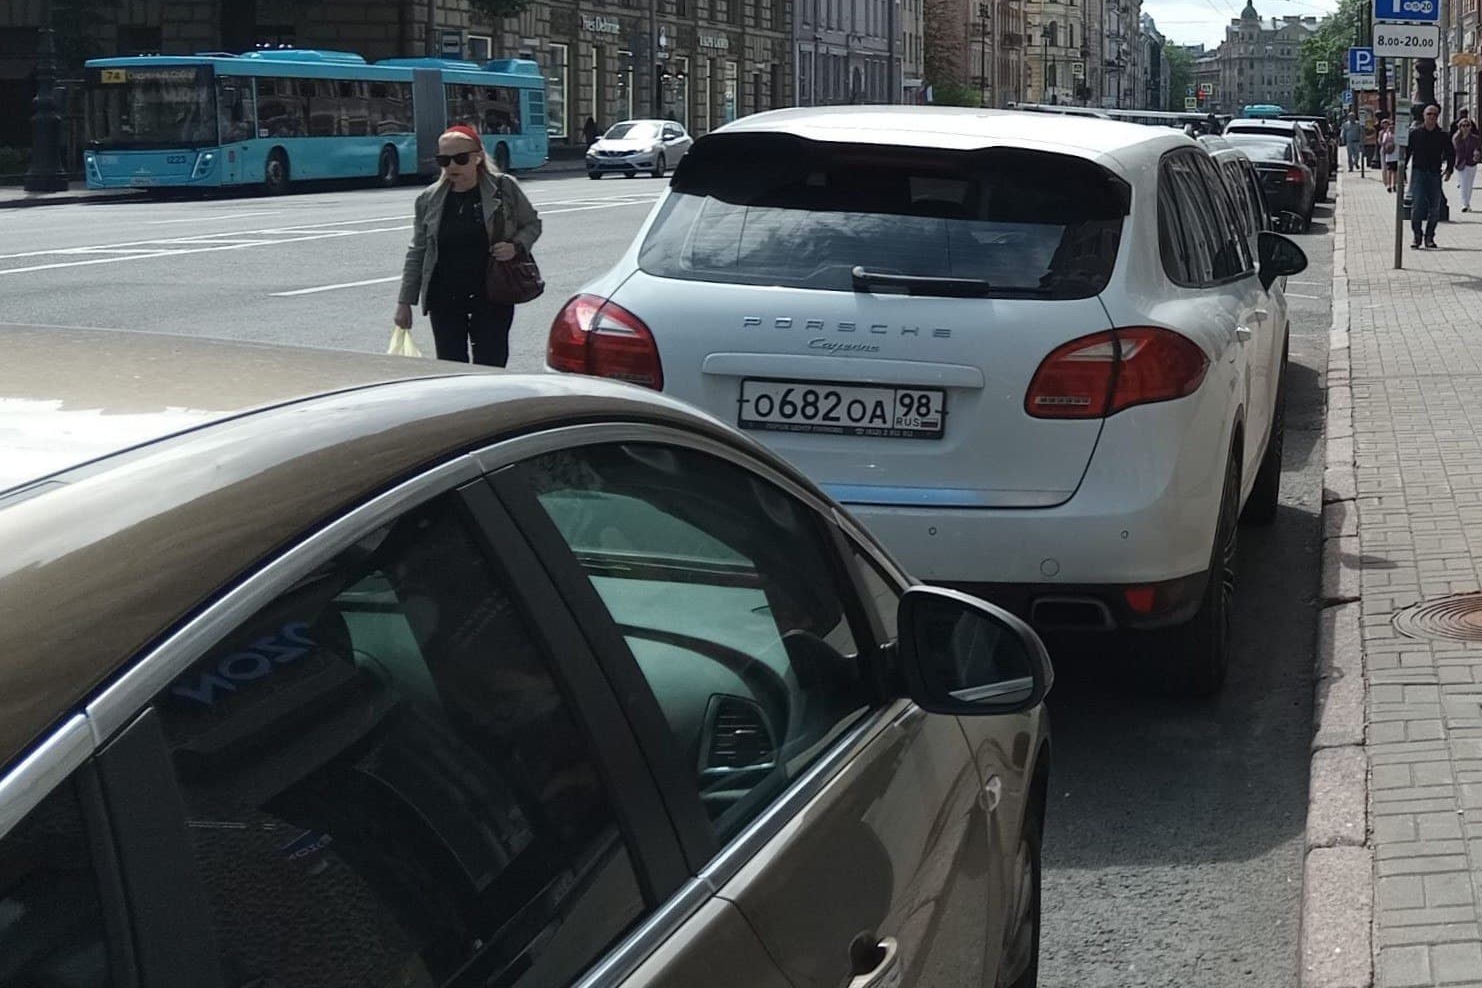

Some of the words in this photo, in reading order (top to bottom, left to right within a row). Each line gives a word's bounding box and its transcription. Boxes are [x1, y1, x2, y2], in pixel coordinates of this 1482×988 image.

[104, 71, 121, 81] 74
[743, 316, 952, 338] PORSCHE
[899, 393, 932, 418] 98
[896, 416, 920, 428] RUS
